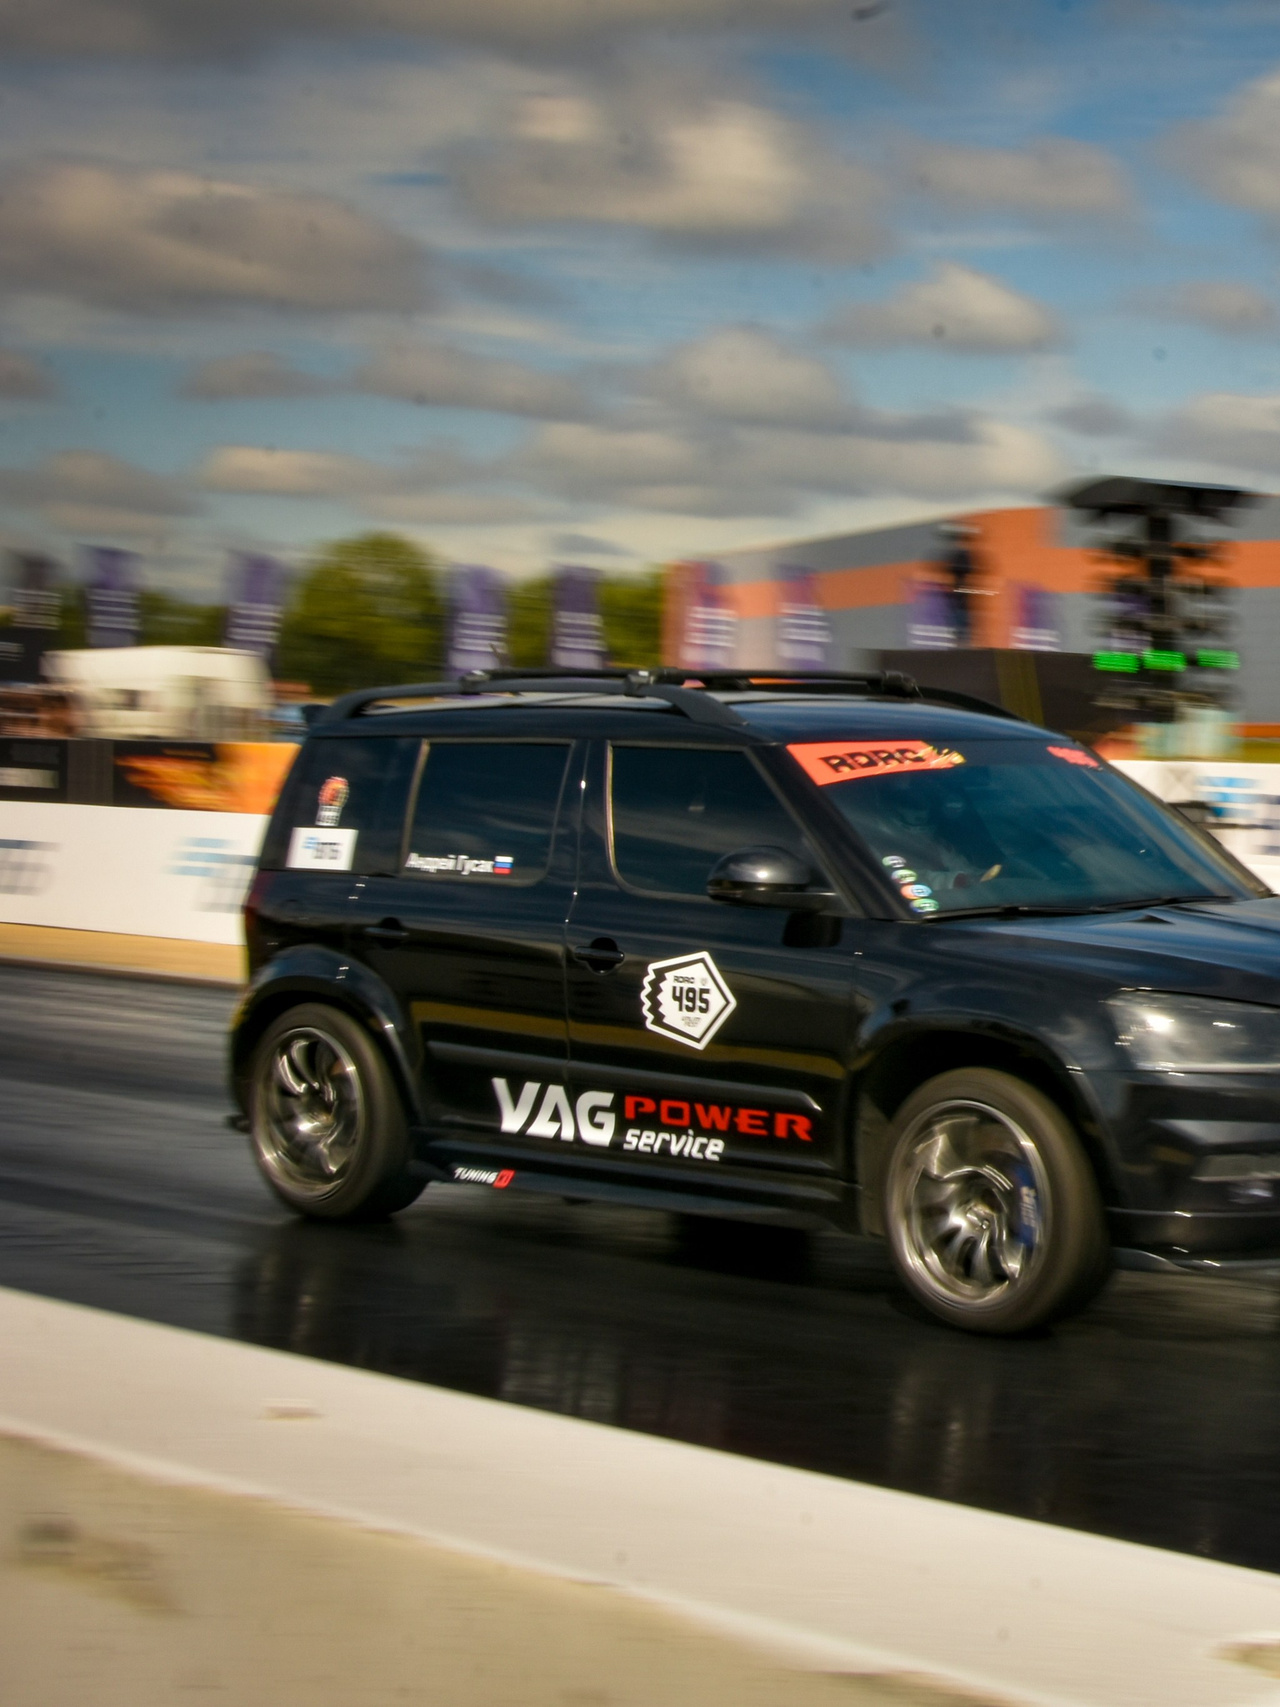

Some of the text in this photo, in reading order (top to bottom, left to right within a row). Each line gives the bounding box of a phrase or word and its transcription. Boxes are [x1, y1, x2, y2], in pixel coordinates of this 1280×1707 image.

[672, 986, 710, 1014] 495
[492, 1077, 813, 1148] VAG POWER
[623, 1128, 725, 1162] service
[454, 1167, 499, 1184] TUNING
